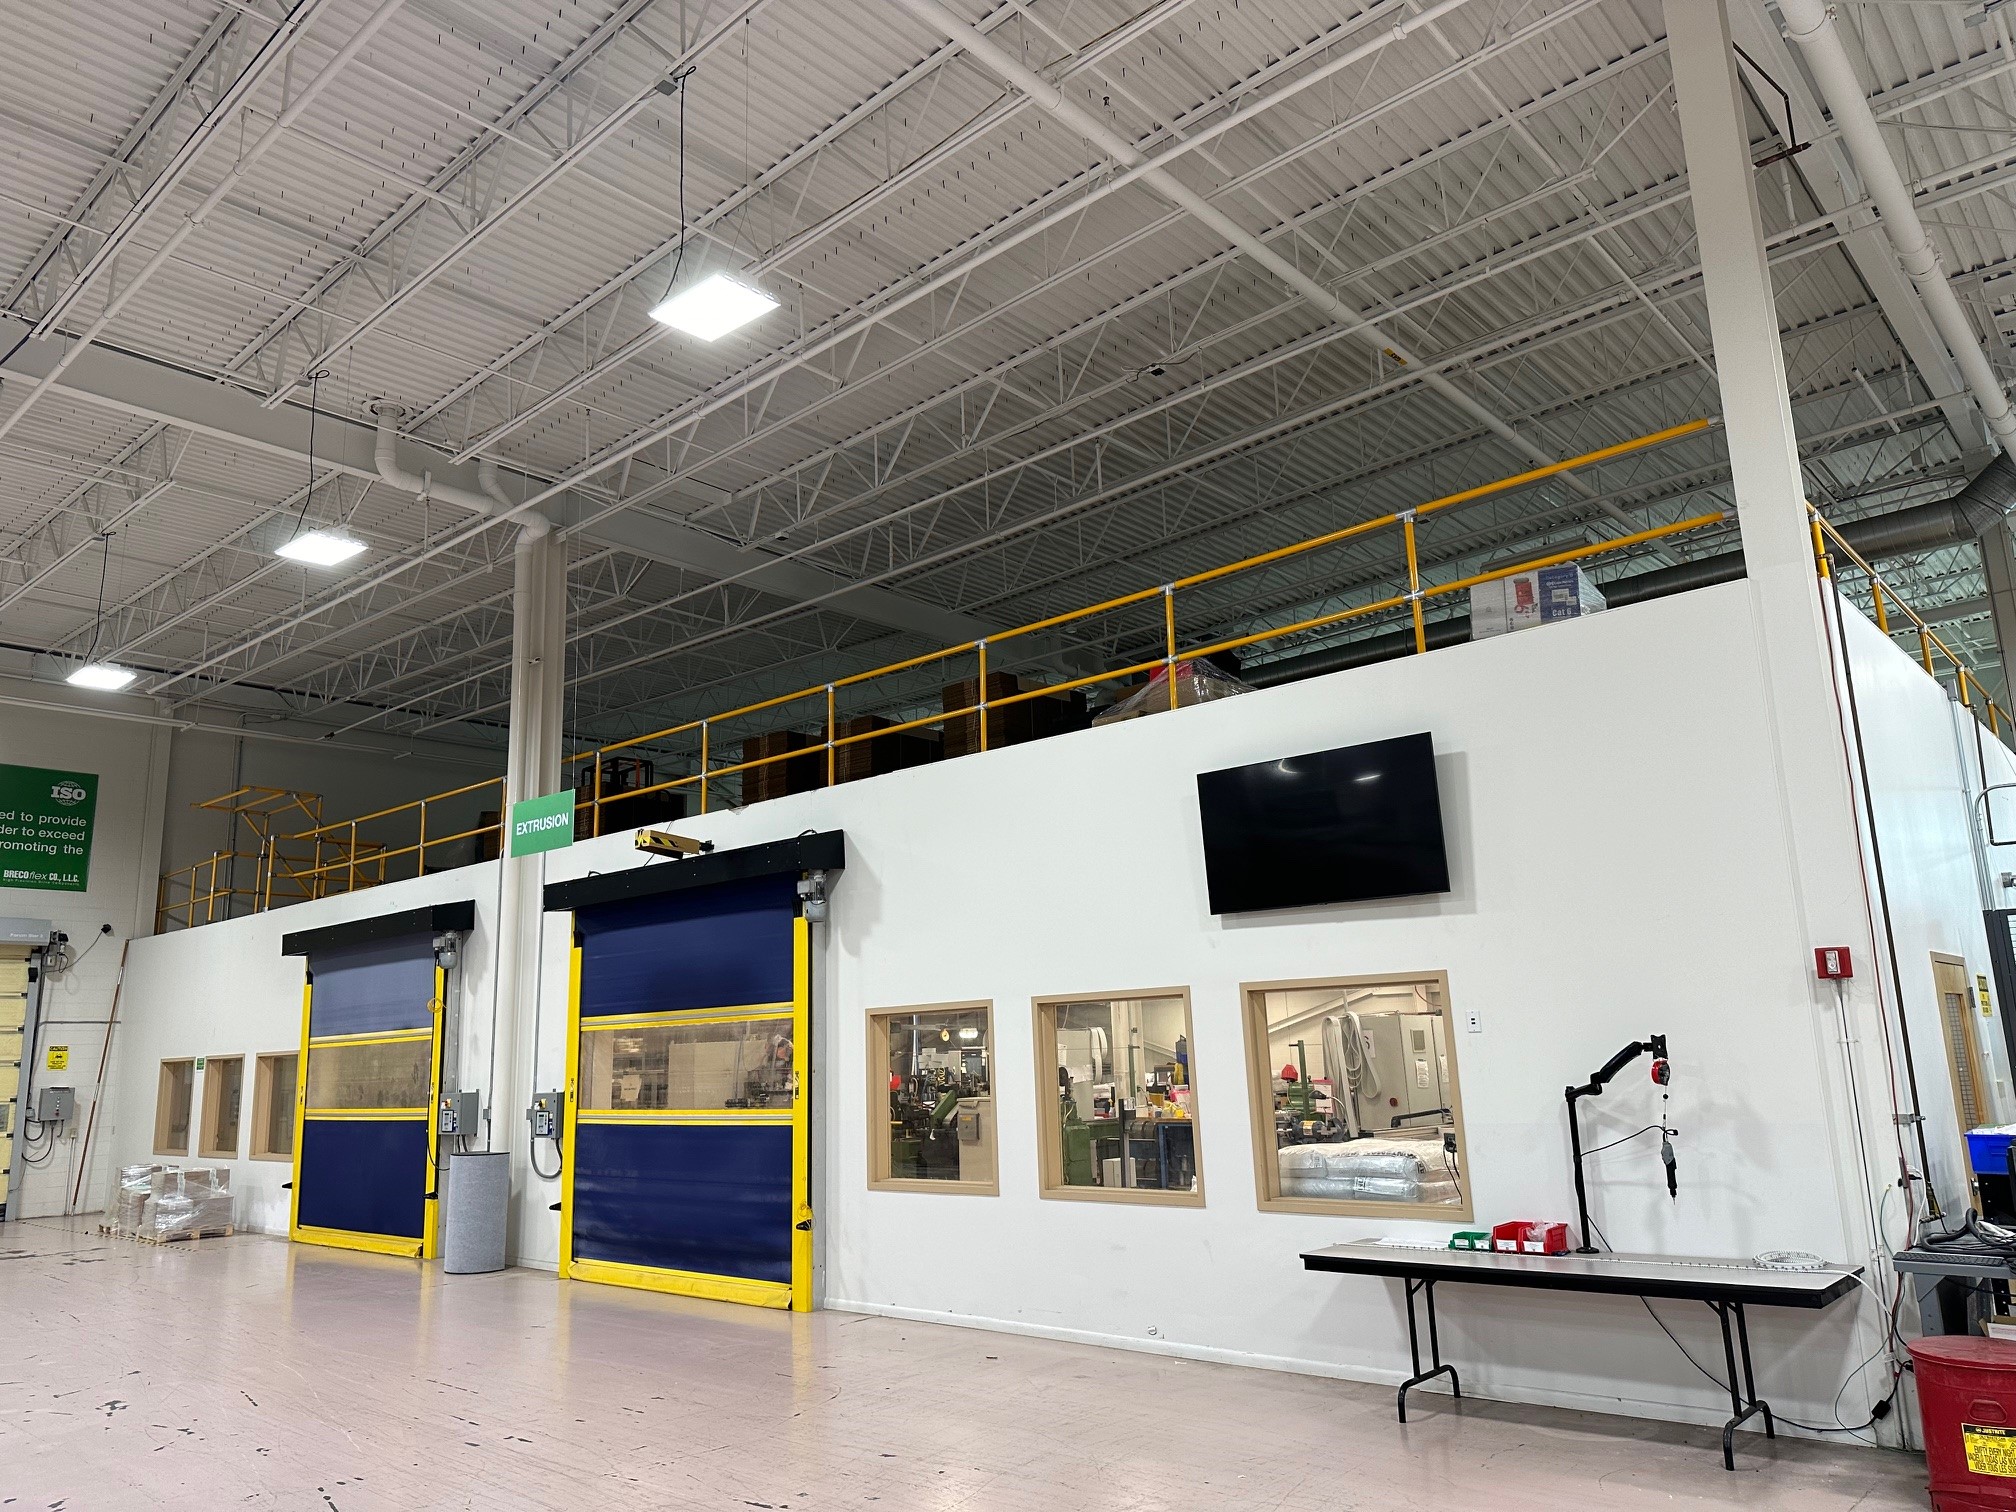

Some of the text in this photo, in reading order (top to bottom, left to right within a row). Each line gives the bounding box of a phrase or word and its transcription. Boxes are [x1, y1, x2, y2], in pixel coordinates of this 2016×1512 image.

[51, 785, 86, 801] ISO
[0, 810, 87, 827] ed to provide
[516, 812, 569, 836] EXTRUSION
[22, 826, 35, 837] to
[38, 829, 85, 841] exceed
[63, 844, 84, 855] the
[3, 869, 48, 880] BRECOflex
[1989, 1447, 2002, 1456] EVERY
